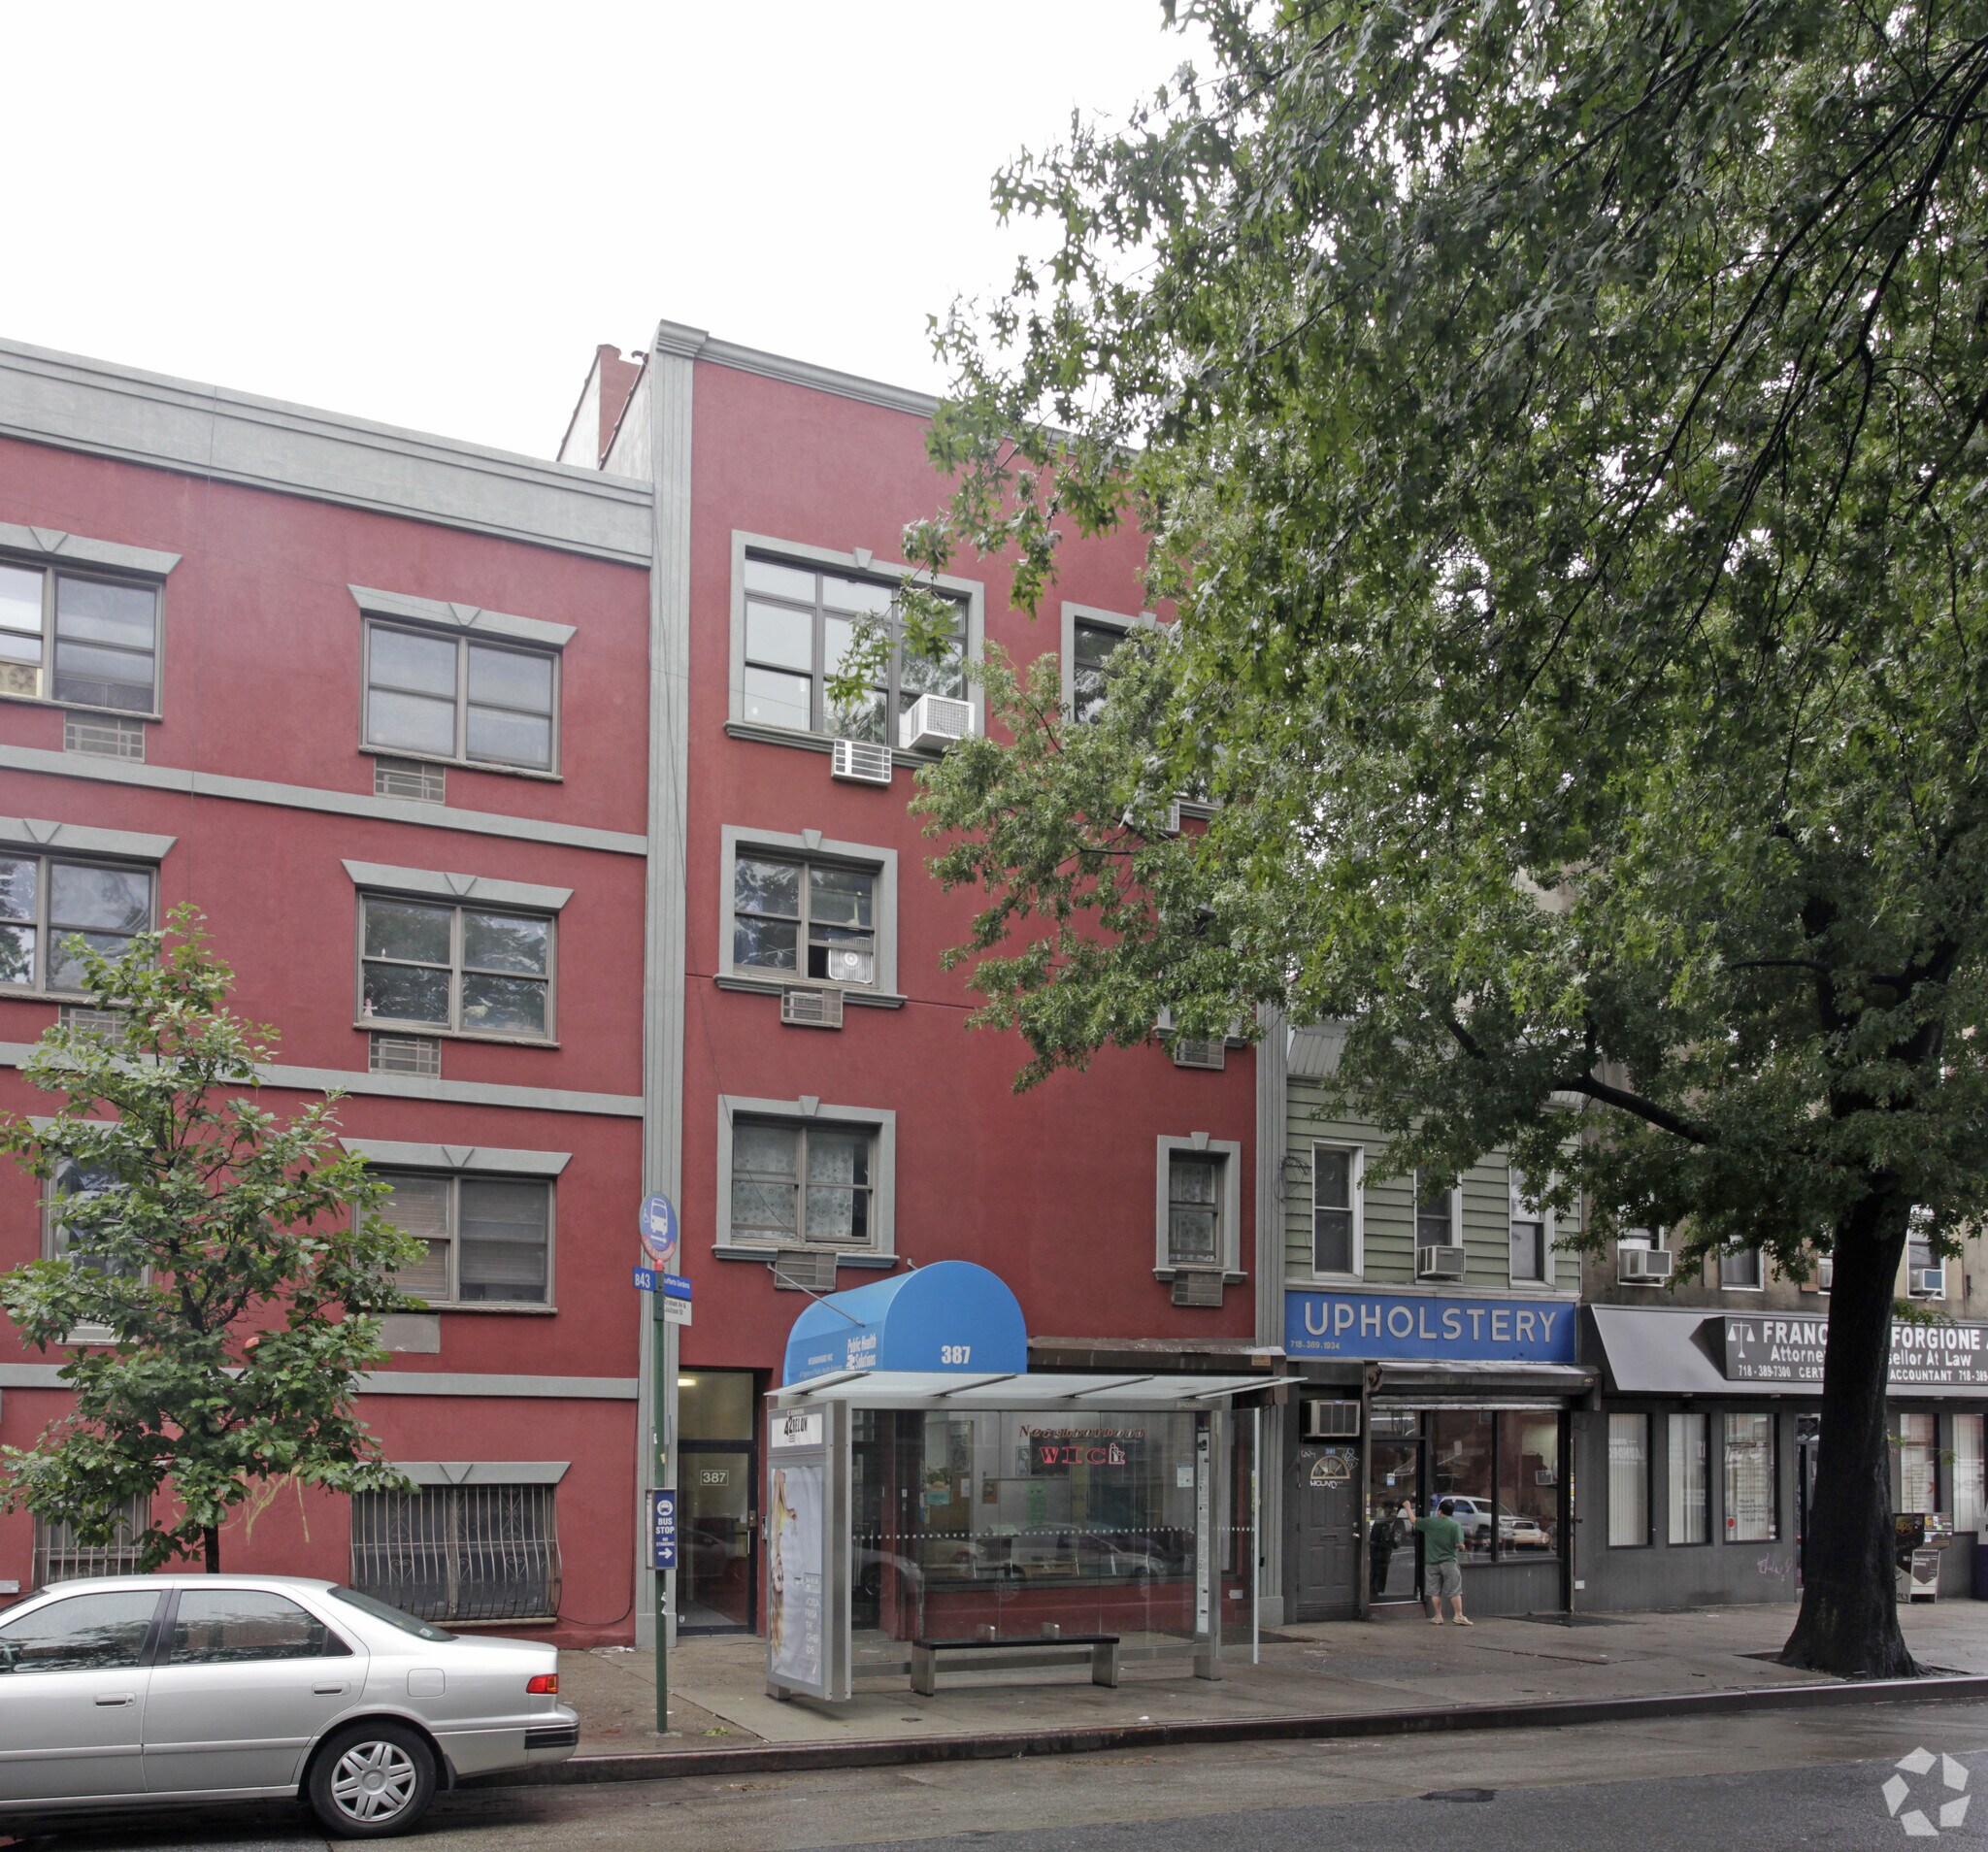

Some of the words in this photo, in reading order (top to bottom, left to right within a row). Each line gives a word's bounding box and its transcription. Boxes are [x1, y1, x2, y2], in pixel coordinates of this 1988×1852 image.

[635, 1273, 650, 1288] B43
[1305, 1301, 1557, 1342] UPHOLSTERY
[847, 1337, 861, 1354] Public
[861, 1333, 877, 1351] Health
[1892, 1326, 1980, 1350] FORGIONE
[855, 1352, 877, 1369] Solutions
[941, 1344, 971, 1365] 387
[1771, 1344, 1826, 1363] Attorne
[1926, 1350, 1939, 1366] At
[1945, 1350, 1971, 1367] Law
[1890, 1368, 1952, 1381] ACCOUNTANT
[1019, 1424, 1145, 1439] Neighborhood
[1039, 1446, 1107, 1465] WIC
[703, 1472, 727, 1483] 387
[1897, 1522, 1913, 1533] ups
